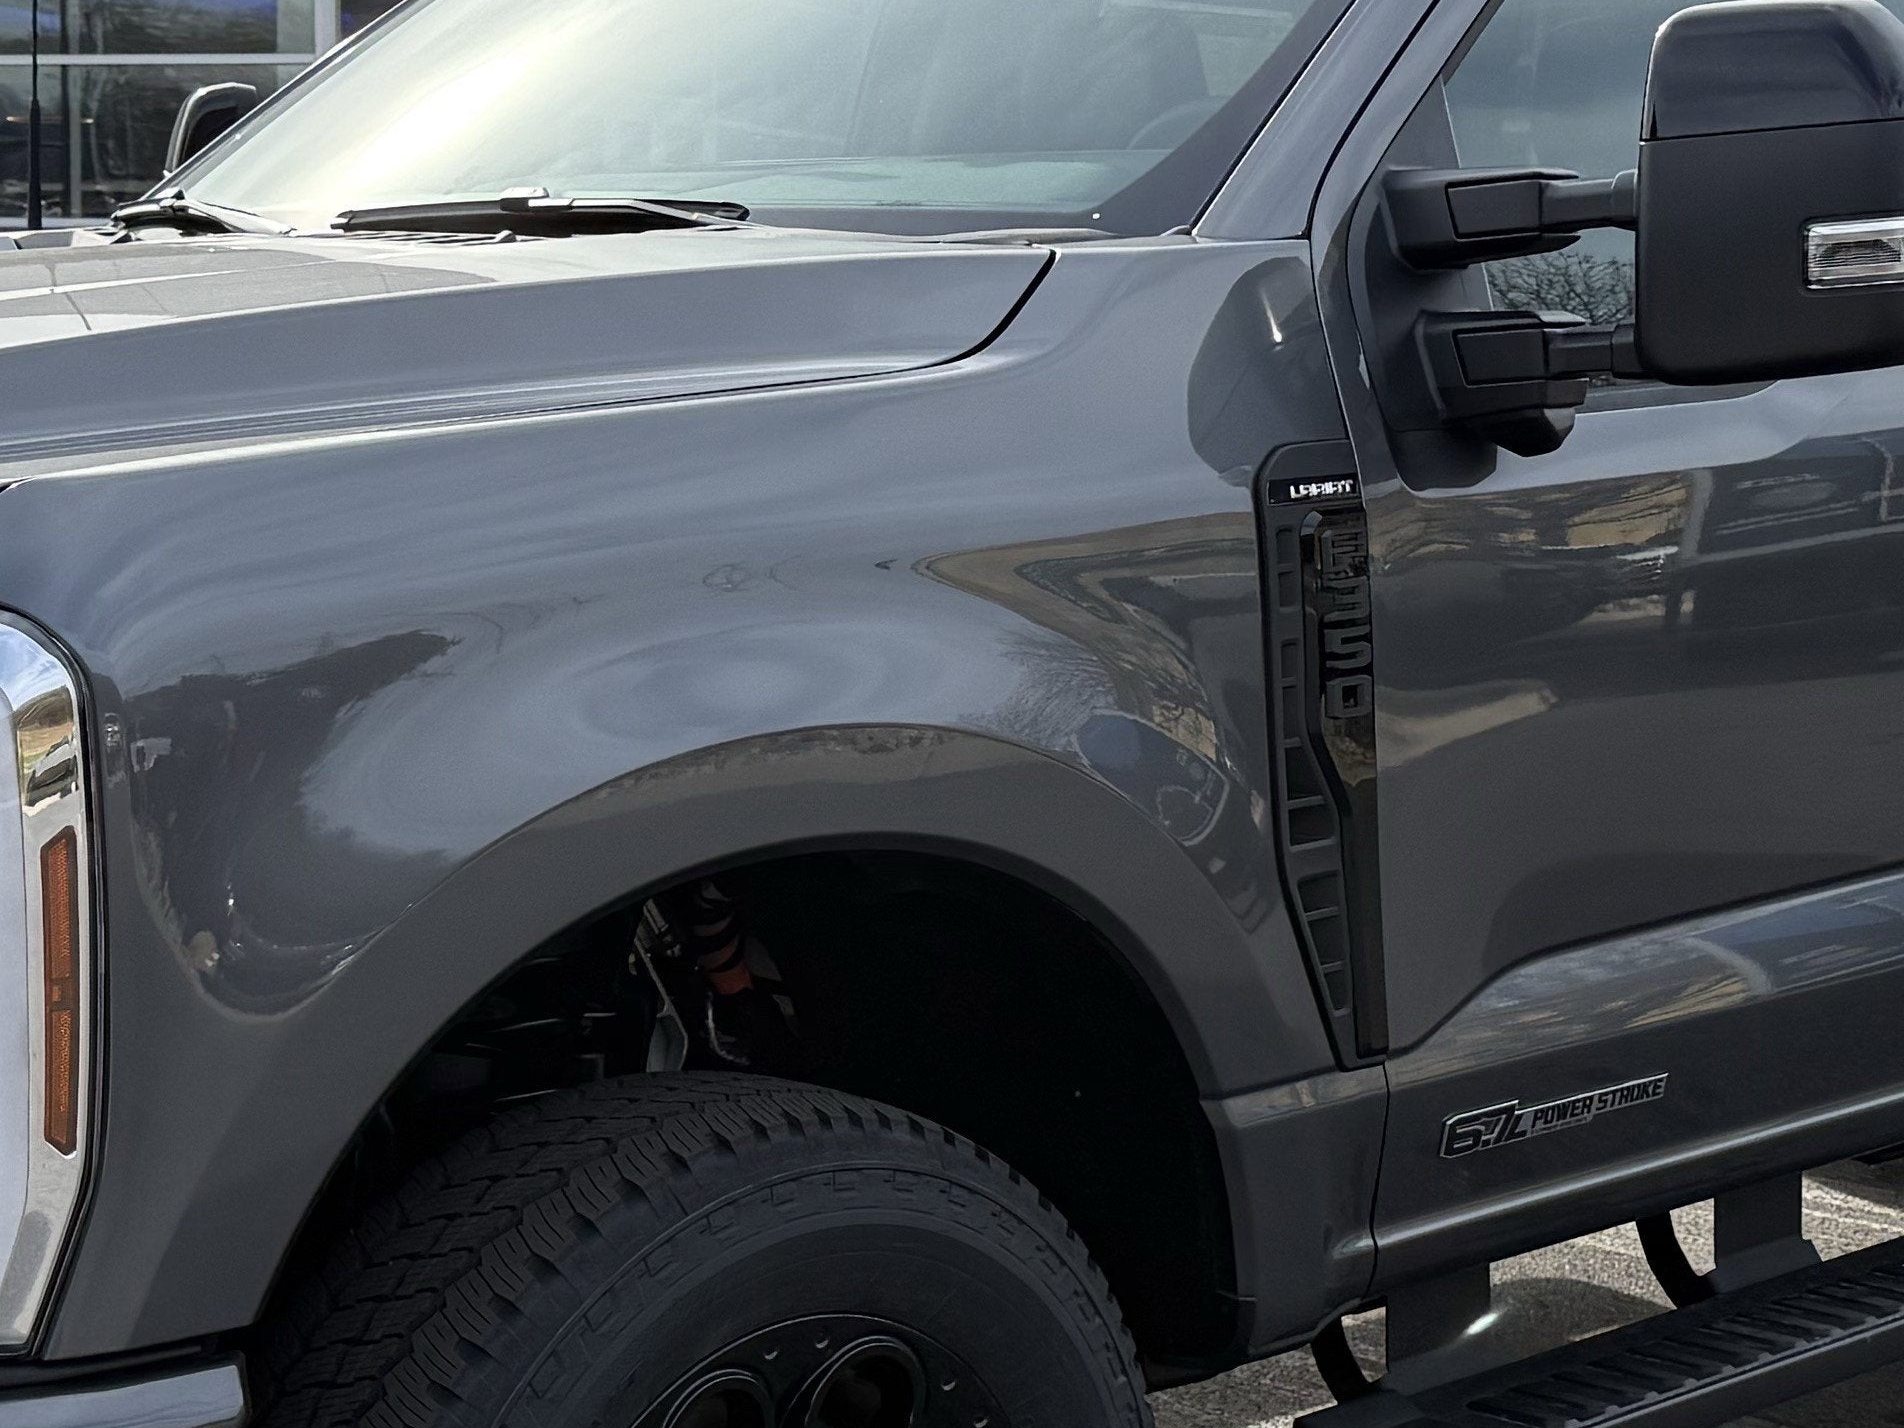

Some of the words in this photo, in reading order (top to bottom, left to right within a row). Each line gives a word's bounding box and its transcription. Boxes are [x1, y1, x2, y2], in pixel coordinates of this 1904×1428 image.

[1443, 1105, 1528, 1156] 6.7L
[1532, 1098, 1594, 1129] POWER
[1595, 1078, 1665, 1112] STROKE
